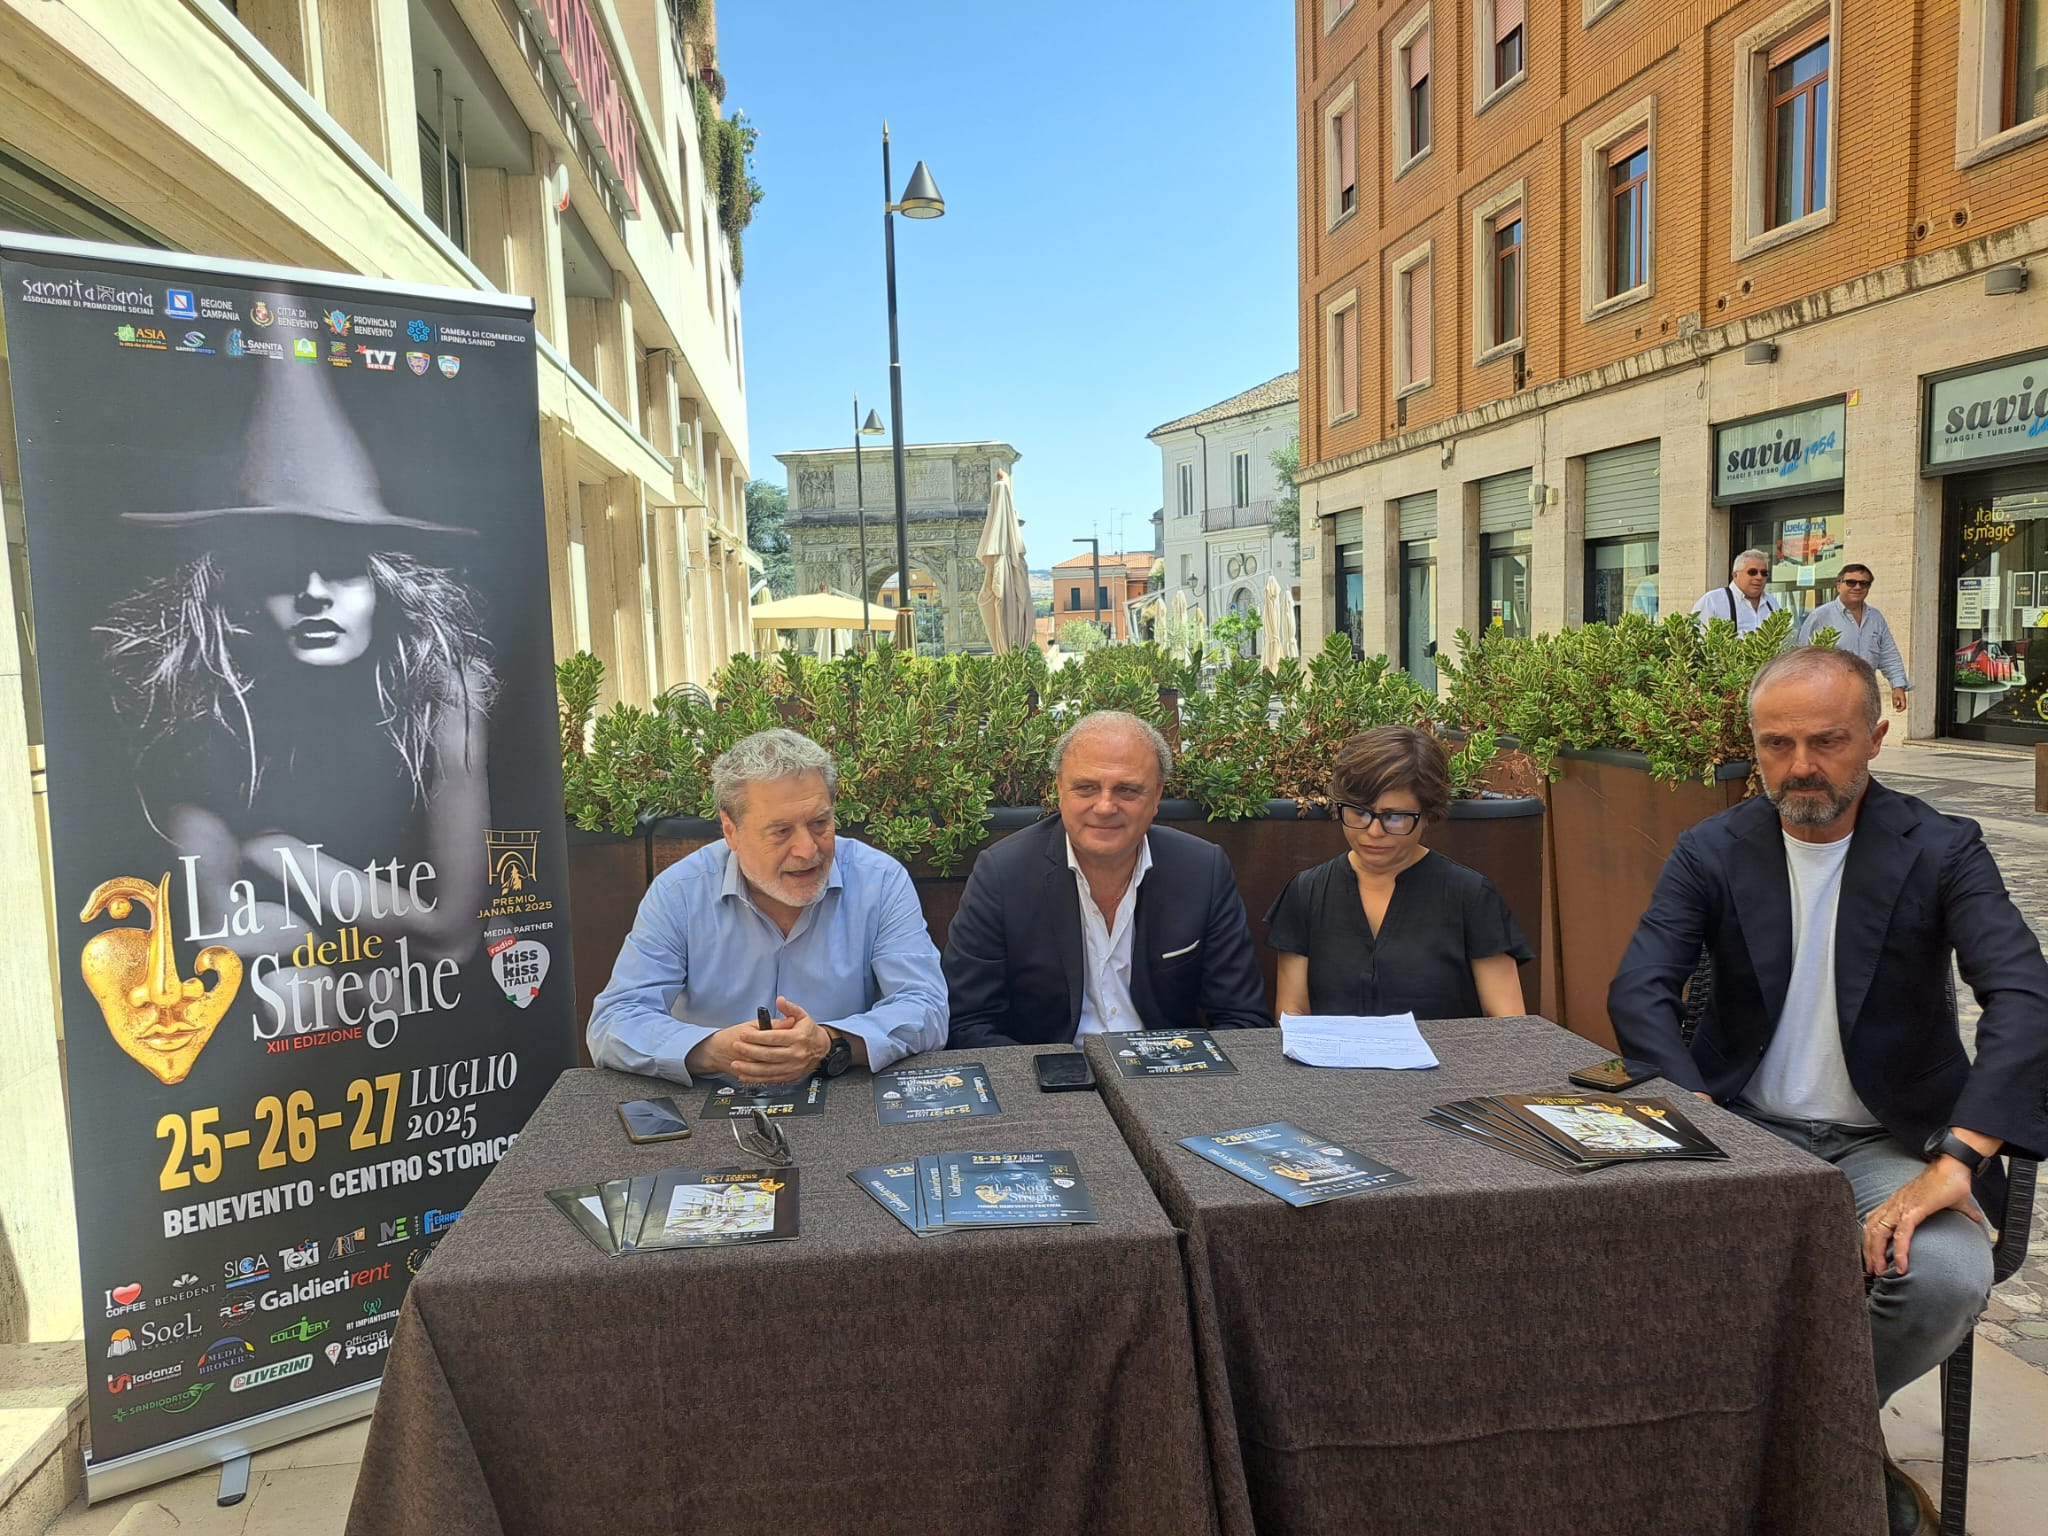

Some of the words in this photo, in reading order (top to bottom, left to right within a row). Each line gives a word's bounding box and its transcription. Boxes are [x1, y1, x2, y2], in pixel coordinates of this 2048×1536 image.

[23, 295, 71, 307] ASSOCIAZIONE
[73, 300, 81, 308] DI
[83, 301, 127, 313] PROMOZIONE
[128, 306, 155, 316] SOCIALE
[200, 298, 233, 310] REGIONE
[201, 309, 240, 322] CAMPANIA
[299, 309, 307, 318] DI
[353, 315, 391, 328] PROVINCIA
[391, 319, 397, 329] DI
[278, 317, 319, 330] BENEVENTO
[354, 326, 394, 338] BENEVENTO
[136, 328, 166, 340] ASIA
[440, 327, 471, 337] CAMERA
[472, 330, 480, 338] DI
[481, 331, 526, 343] COMMERCIO
[440, 335, 467, 344] IRPINIA
[467, 338, 496, 347] SANNIO
[248, 340, 284, 351] SANNITA
[365, 349, 397, 366] TV7
[1945, 433, 1974, 444] VIAGGI
[1987, 424, 2026, 437] TURISMO
[1727, 429, 1802, 472] savia
[1804, 430, 1836, 464] 1954
[1753, 467, 1779, 476] TURISMO
[1964, 524, 1974, 540] is
[1974, 522, 2016, 541] magic
[178, 854, 264, 942] La
[273, 844, 438, 931] Notte
[492, 894, 536, 907] PREMIO
[476, 905, 522, 919] JANARA
[525, 901, 553, 912] 2025
[483, 928, 513, 938] MEDIA
[513, 922, 553, 935] PARTNER
[292, 926, 384, 969] delle
[490, 939, 514, 955] radio
[502, 949, 538, 965] kiss
[503, 963, 539, 979] kiss
[504, 976, 539, 988] ITALIA
[250, 936, 462, 1049] Streghe
[266, 1038, 291, 1055] XIII
[293, 1027, 363, 1050] EDIZIONE
[408, 1051, 518, 1108] LUGLIO
[407, 1103, 478, 1141] 2025
[155, 1072, 402, 1192] 25-26-27
[163, 1179, 314, 1239] BENEVENTO
[330, 1155, 422, 1197] CENTRO
[224, 1254, 269, 1278] SICA
[279, 1242, 320, 1273] Texi
[154, 1283, 217, 1306] BENEDENT
[260, 1261, 391, 1311] Galdierirent
[104, 1290, 113, 1309] I
[220, 1299, 256, 1317] RCS
[105, 1301, 147, 1318] COFFEE
[355, 1309, 400, 1328] IMPIANTISTICA
[345, 1329, 387, 1347] officina
[207, 1347, 245, 1361] MEDIA
[345, 1336, 393, 1359] Pugli
[199, 1353, 256, 1375] BROKER'S
